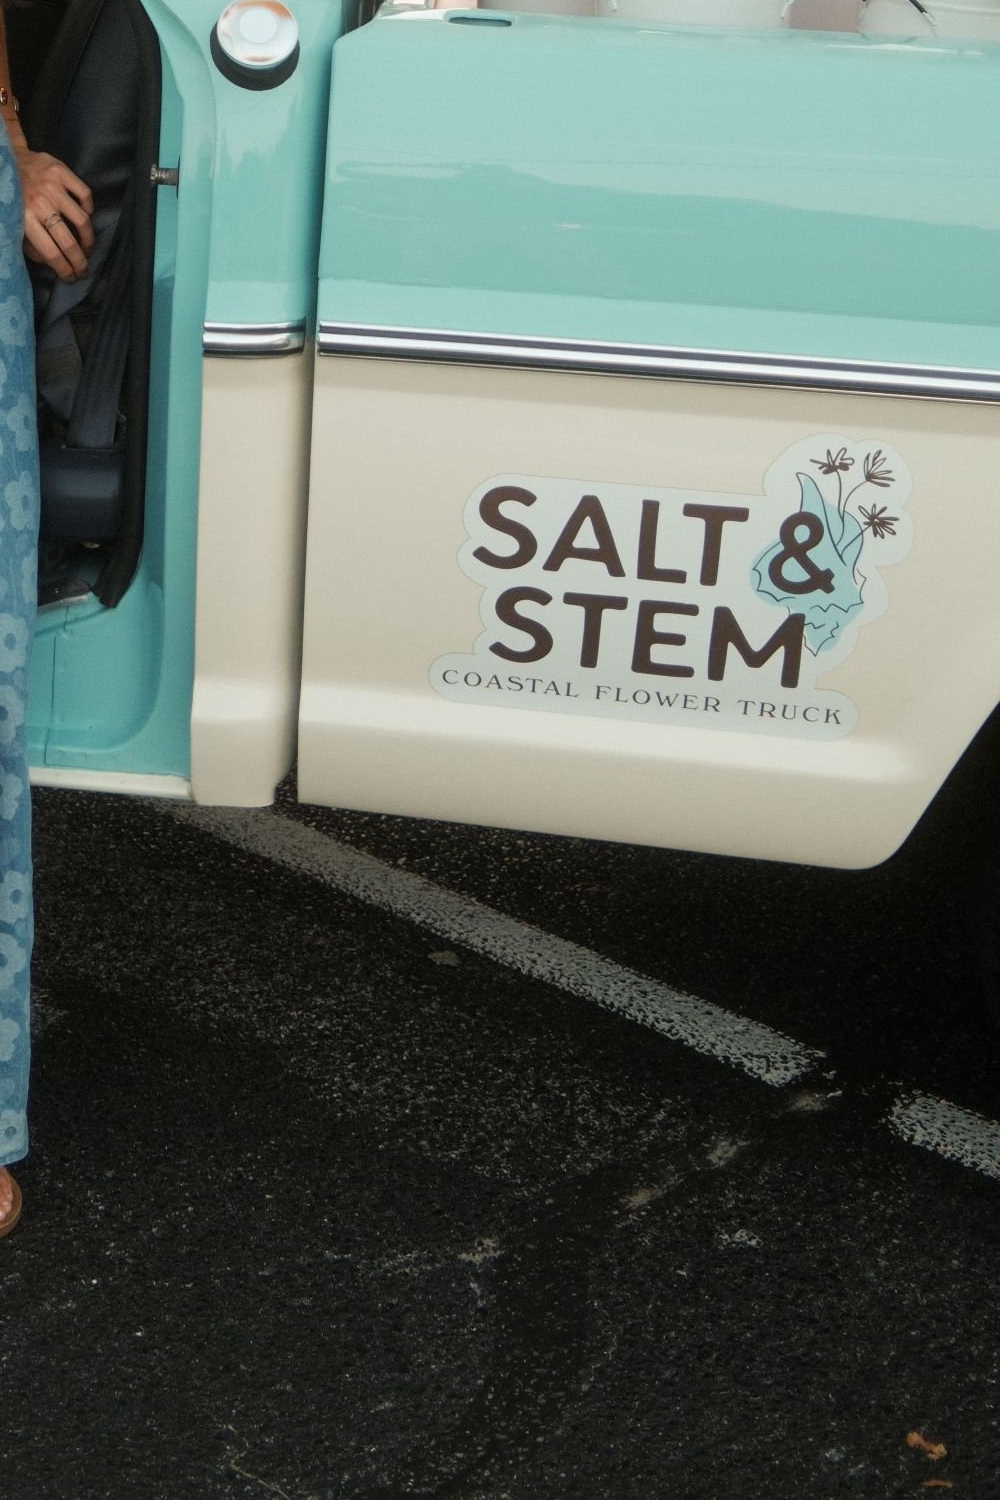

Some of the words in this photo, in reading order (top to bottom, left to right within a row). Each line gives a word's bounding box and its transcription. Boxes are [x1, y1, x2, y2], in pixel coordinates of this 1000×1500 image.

[472, 486, 749, 586] SALT
[768, 511, 836, 595] &
[489, 586, 806, 688] STEM
[442, 669, 579, 698] COASTAL
[594, 684, 721, 713] FLOWER
[738, 699, 842, 725] TRUCK
